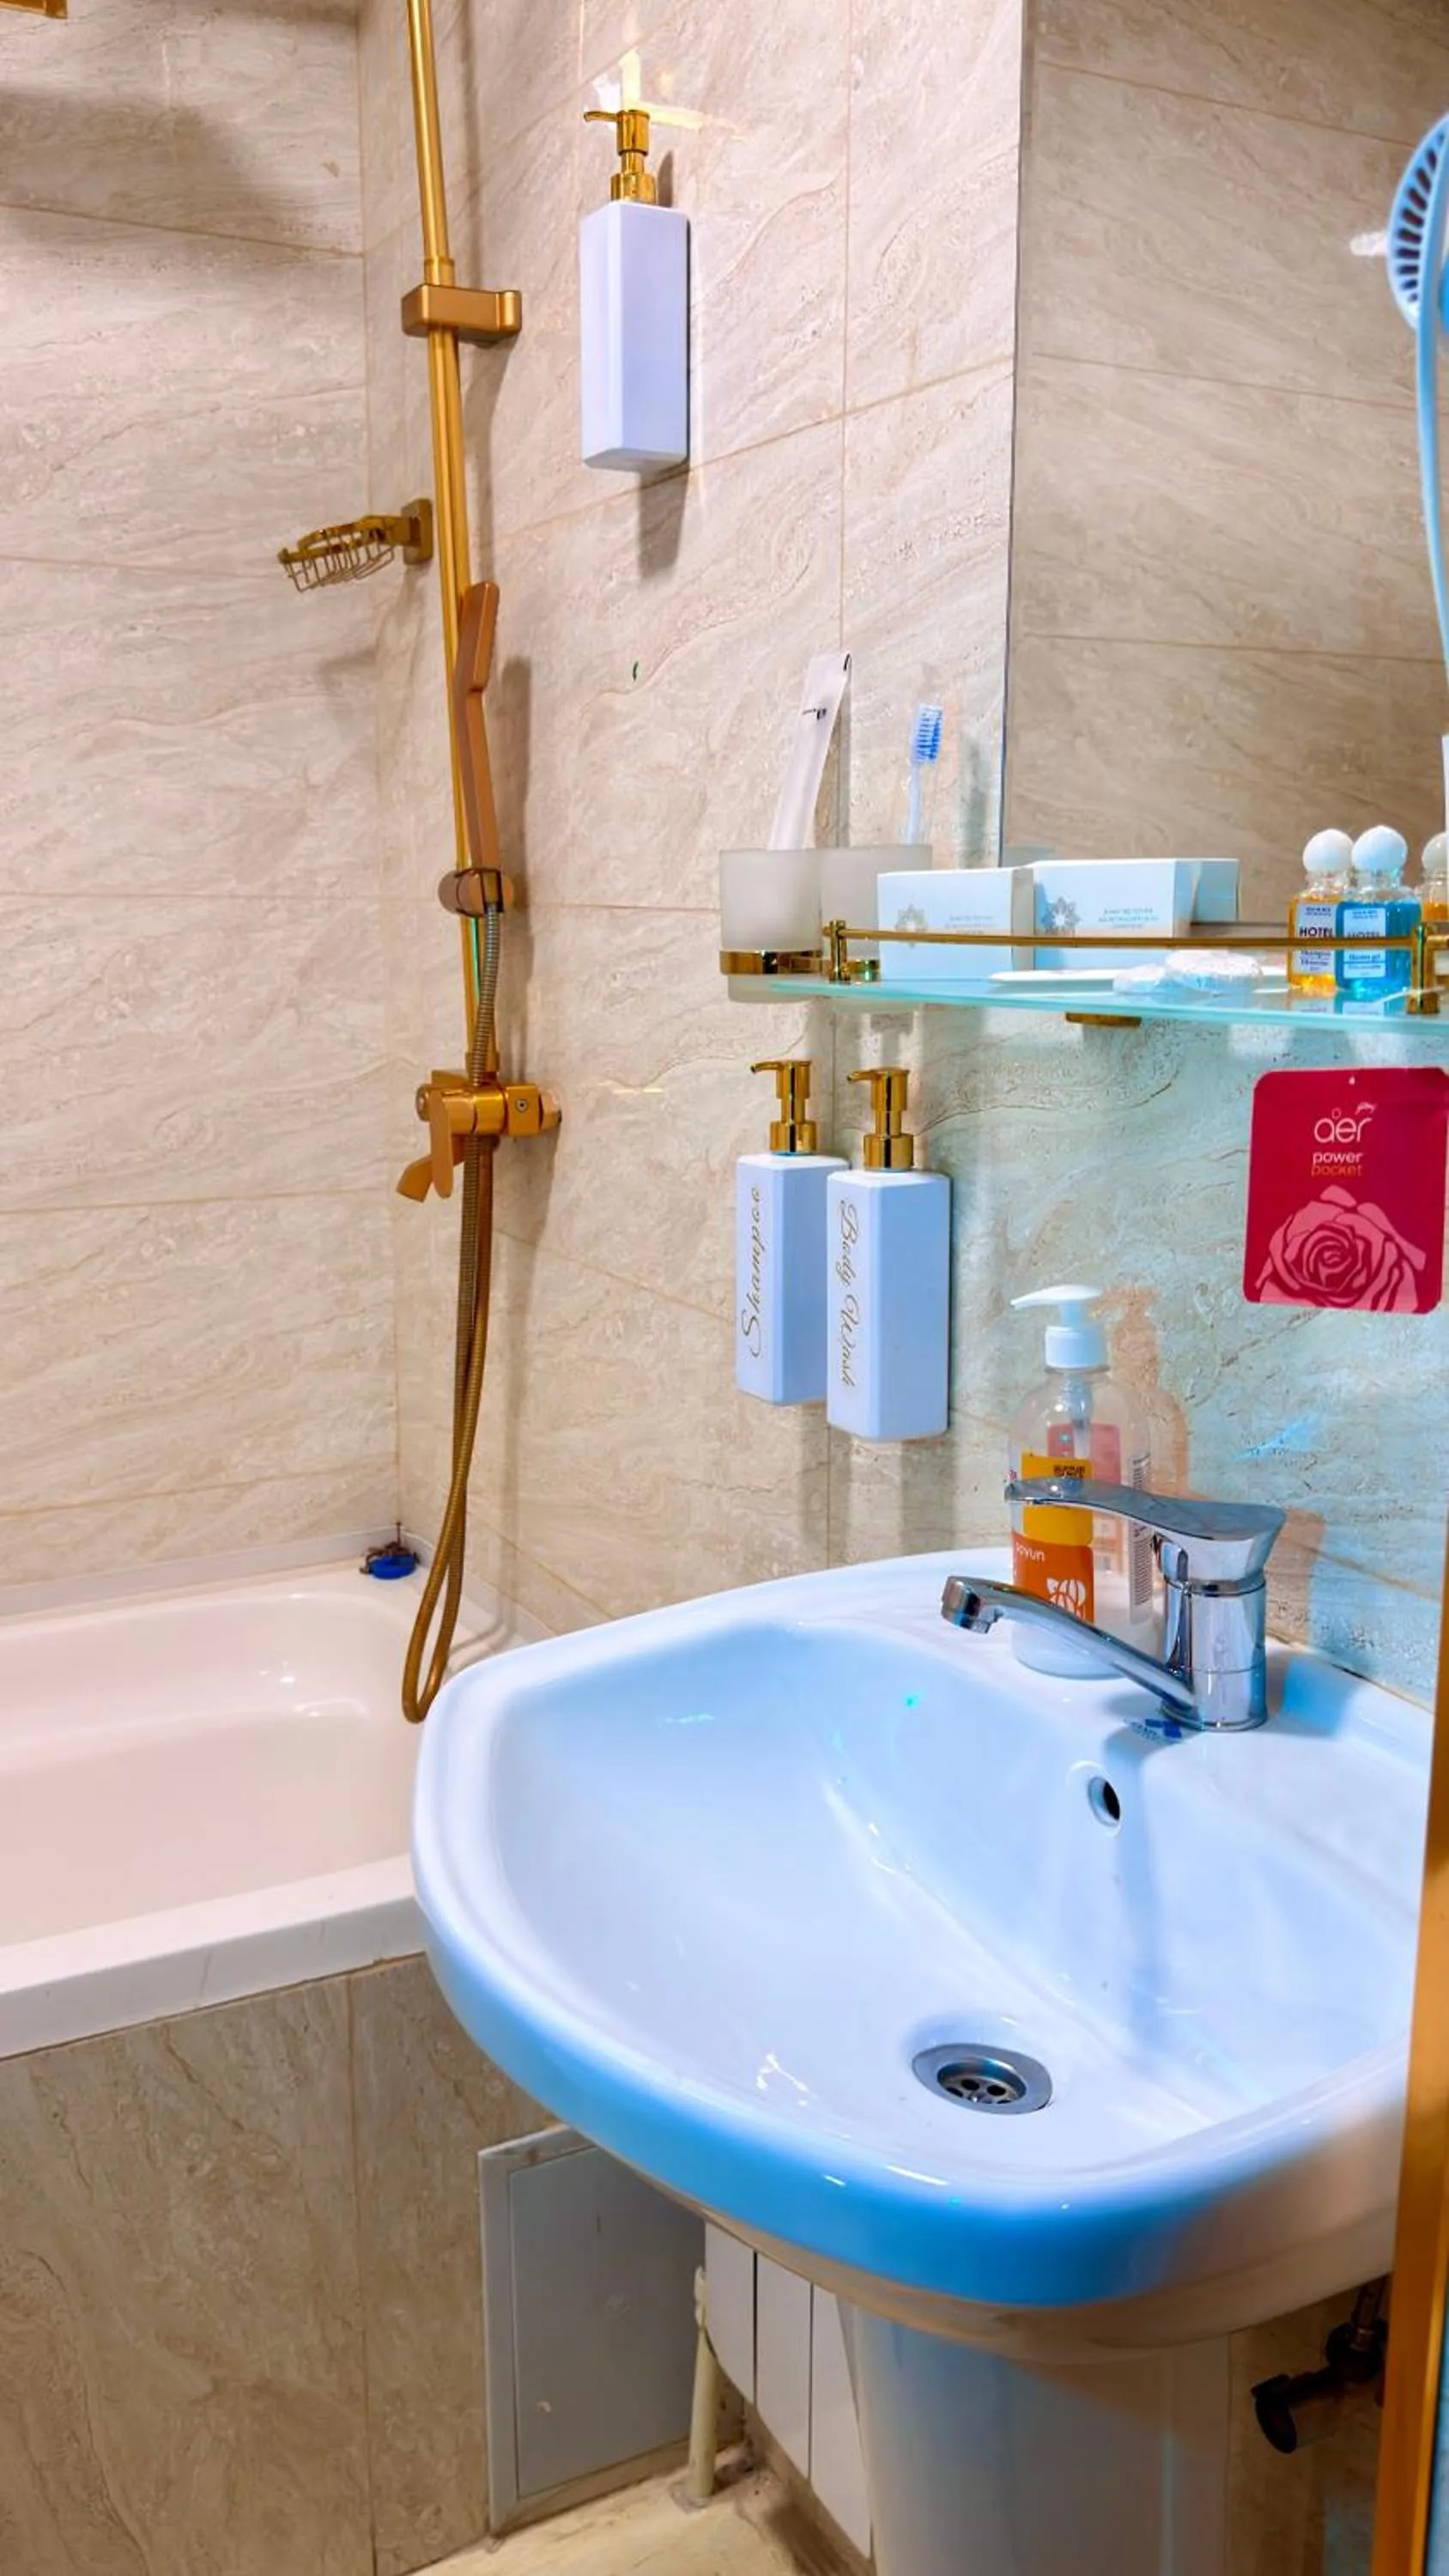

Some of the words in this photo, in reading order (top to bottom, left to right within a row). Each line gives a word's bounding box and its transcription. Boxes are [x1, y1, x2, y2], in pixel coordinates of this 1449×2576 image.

[1299, 927, 1332, 938] HOTEL
[1311, 1163, 1362, 1177] pocket
[1313, 1151, 1363, 1164] power
[834, 1199, 859, 1287] Body
[741, 1187, 767, 1358] Shampoo
[839, 1293, 861, 1388] Wash
